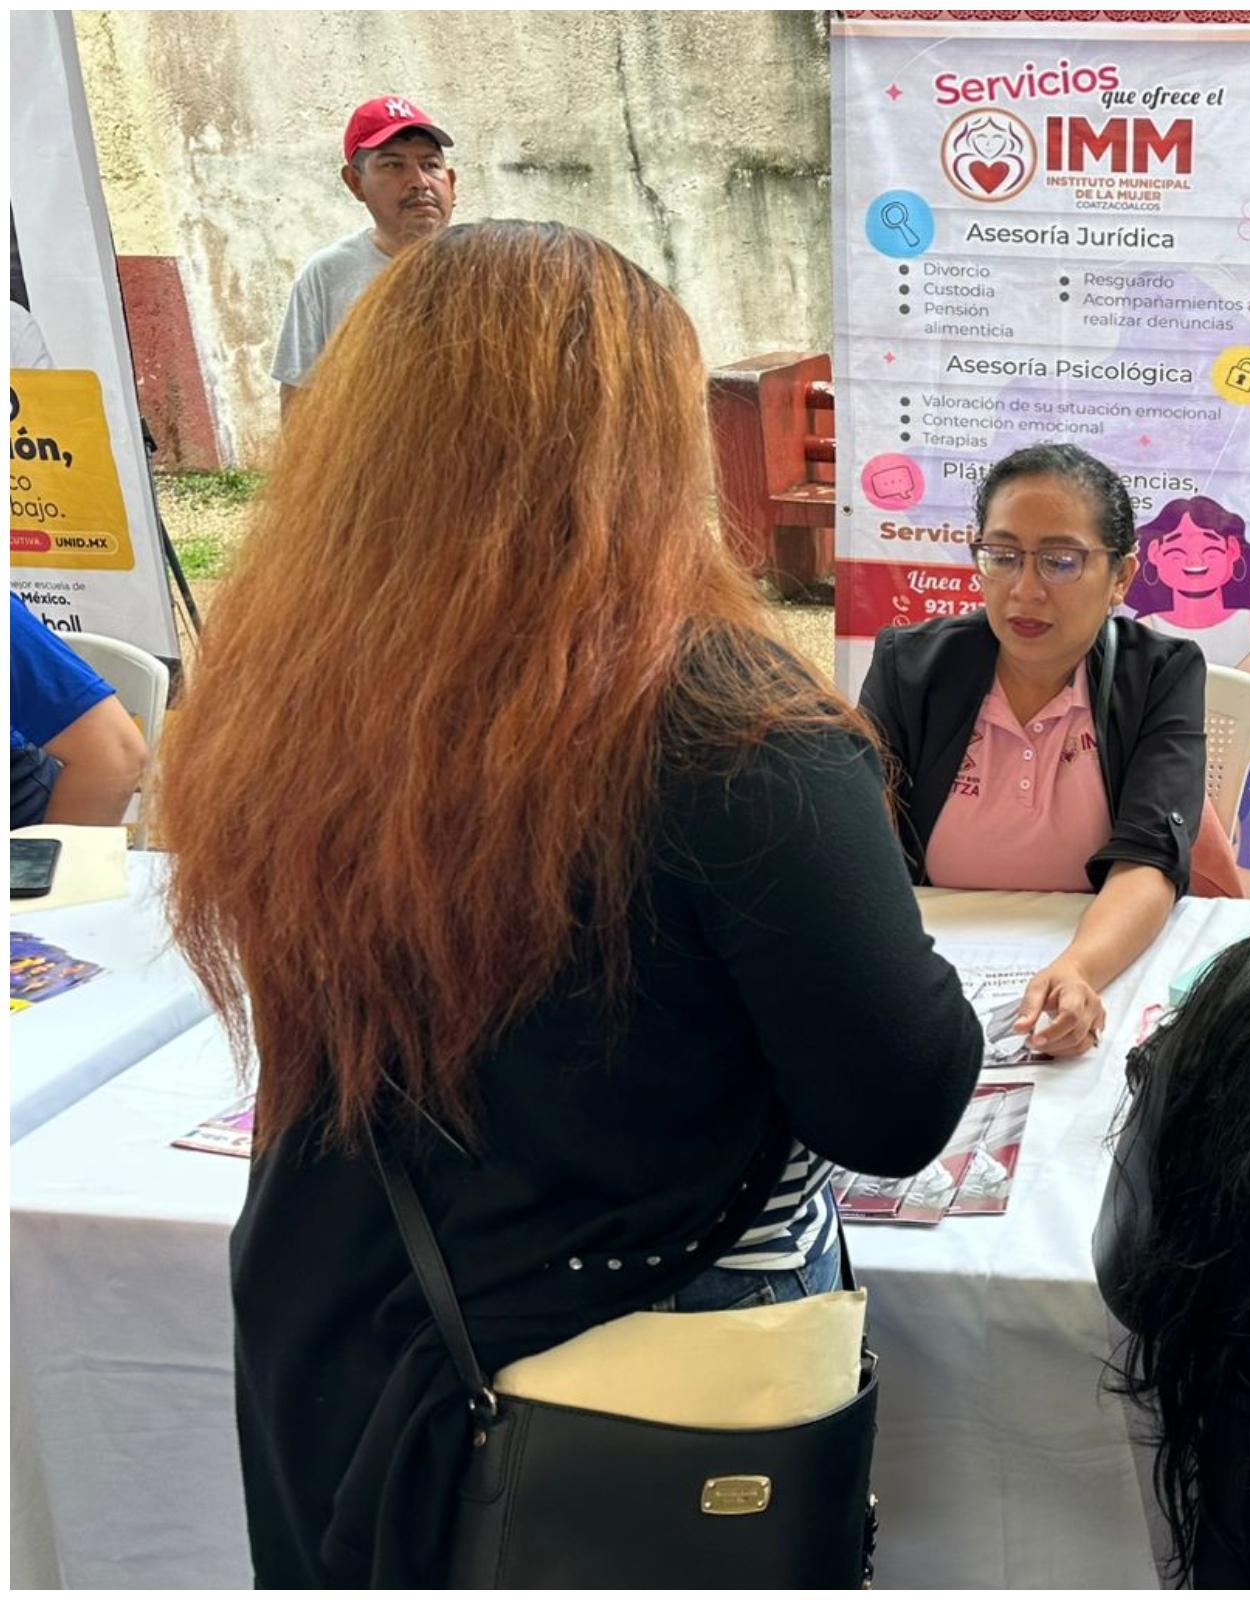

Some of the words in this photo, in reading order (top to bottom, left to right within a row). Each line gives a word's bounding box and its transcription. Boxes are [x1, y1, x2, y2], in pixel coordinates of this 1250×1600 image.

[935, 60, 1119, 105] Servicios
[1101, 91, 1136, 109] que
[1142, 87, 1200, 109] ofrece
[1206, 89, 1224, 106] el
[1046, 116, 1193, 174] IMM
[1047, 177, 1115, 188] INSTITUTO
[1119, 178, 1191, 190] MUNICIPAL
[1075, 190, 1093, 200] DE
[1096, 190, 1113, 200] LA
[1117, 190, 1161, 201] MUJER
[1076, 201, 1161, 212] COATZACOALCOS
[966, 223, 1070, 245] Asesoría
[1076, 226, 1175, 248] Jurídica
[924, 263, 990, 278] Divorcio
[924, 282, 995, 298] Custodia
[1084, 273, 1174, 290] Resguardo
[924, 302, 989, 317] Pensión
[1083, 293, 1243, 313] Acompañamientos
[924, 323, 1014, 338] alimenticia
[1084, 314, 1141, 327] realizar
[1147, 314, 1234, 331] denuncias
[946, 355, 1048, 376] Asesoría
[1056, 360, 1193, 386] Psicológica
[922, 395, 1005, 411] Valoración
[1010, 400, 1029, 412] de
[1034, 403, 1053, 414] su
[1057, 402, 1131, 417] situación
[1136, 406, 1222, 421] emocional
[922, 413, 1014, 430] Contención
[1018, 419, 1104, 435] emocional
[922, 432, 988, 448] Terapias
[10, 475, 32, 491] co
[1120, 472, 1198, 493] encias,
[10, 495, 66, 523] bajo.
[1129, 495, 1153, 510] es
[880, 521, 975, 544] Servici
[55, 537, 108, 548] UNID.MX
[907, 570, 962, 594] Línea
[925, 599, 955, 614] 921
[953, 782, 980, 797] TZA
